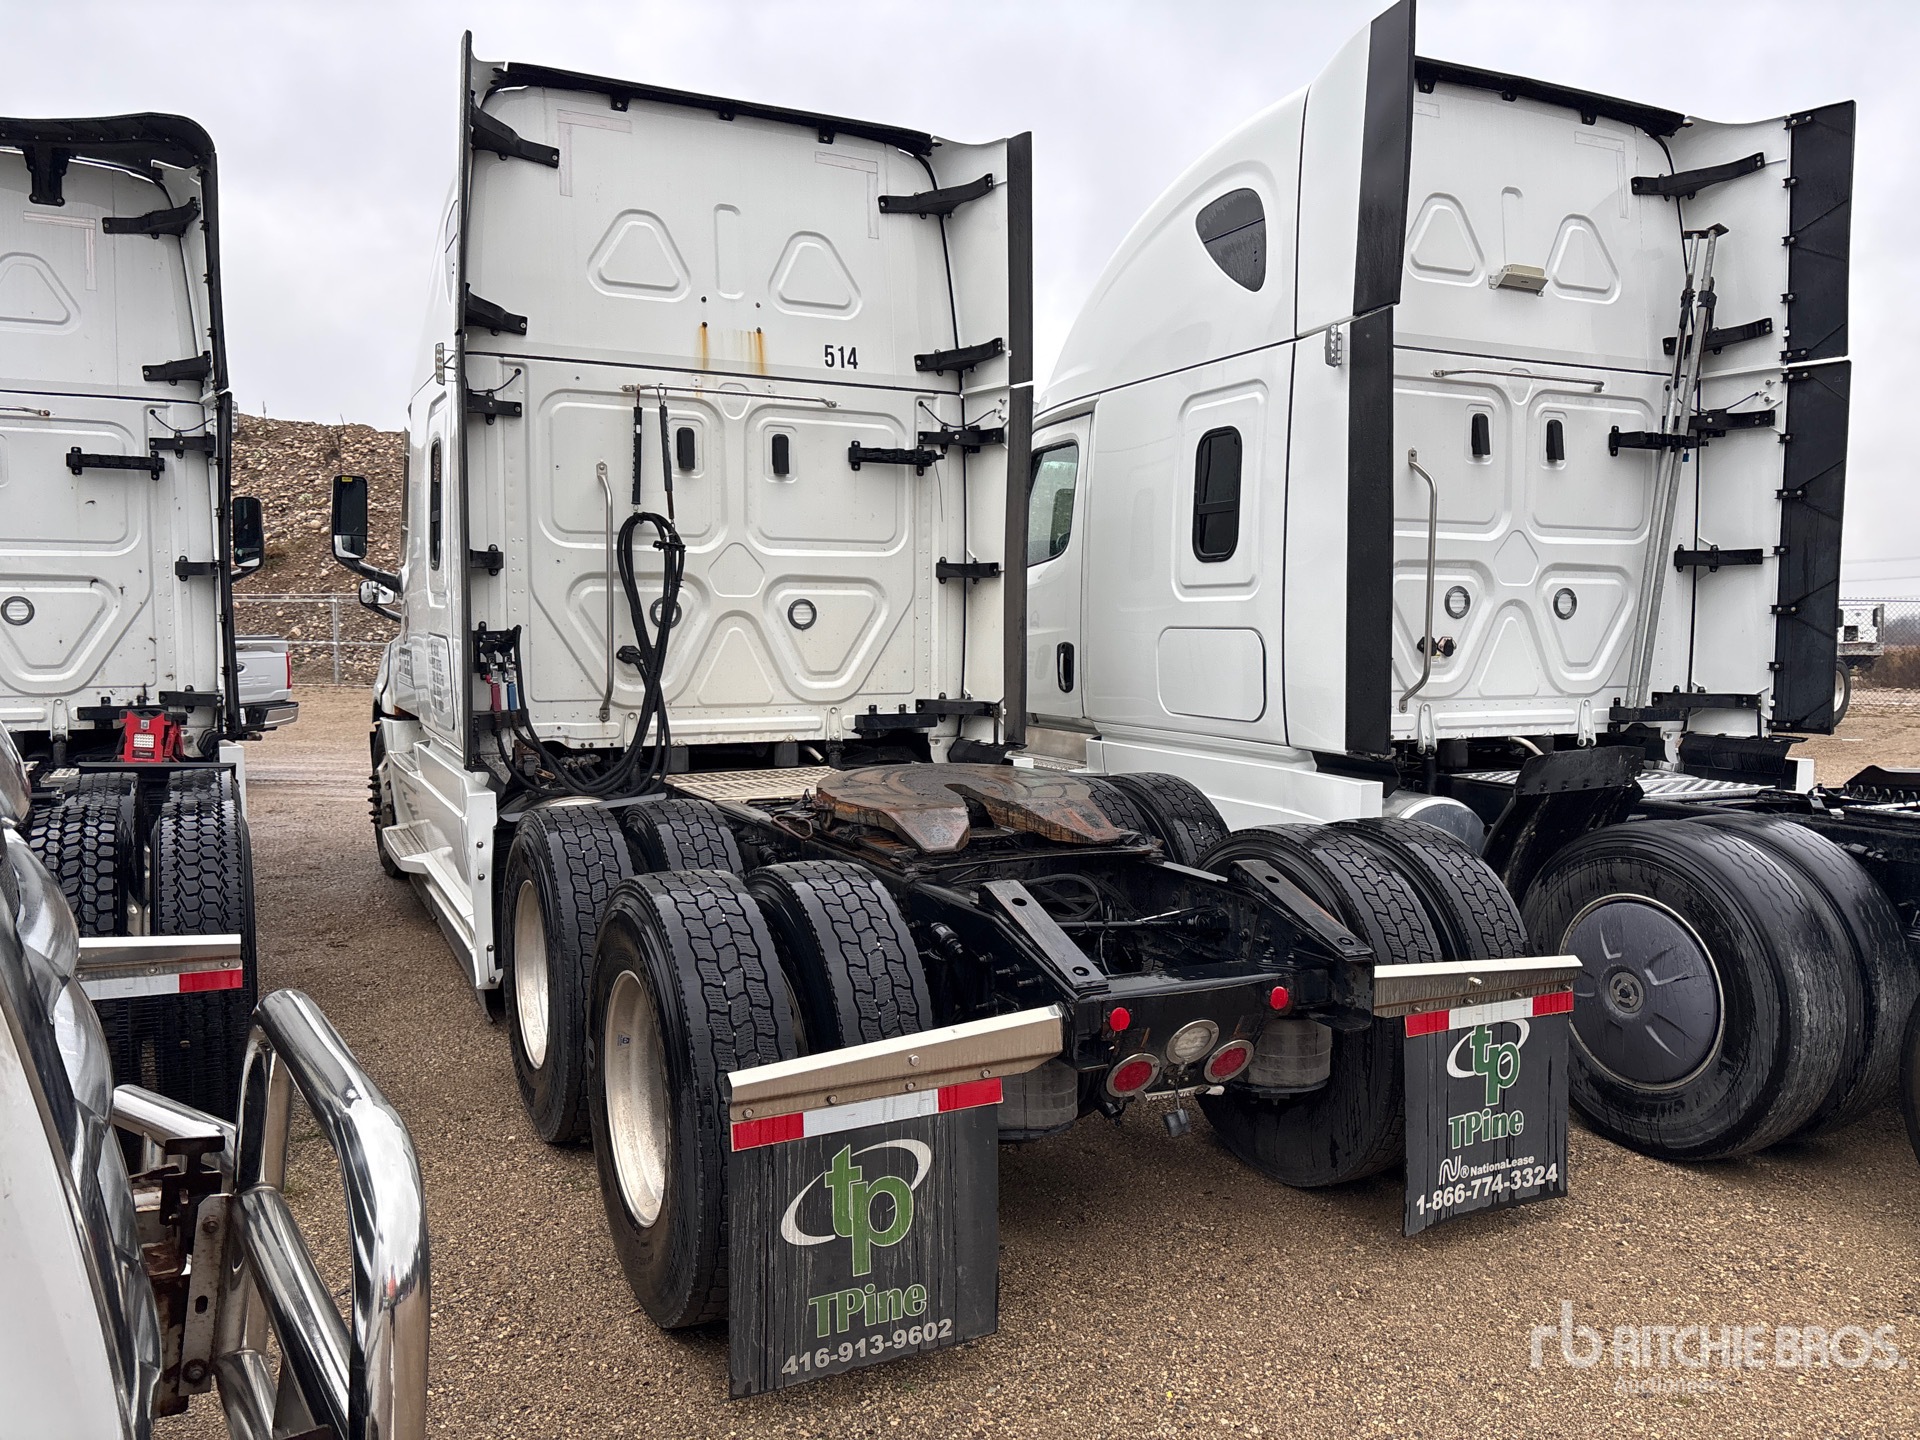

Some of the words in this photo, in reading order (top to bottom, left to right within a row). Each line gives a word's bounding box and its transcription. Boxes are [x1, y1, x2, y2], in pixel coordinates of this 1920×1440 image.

[825, 344, 858, 369] 514
[1449, 1108, 1524, 1150] TPine
[1416, 1163, 1558, 1215] 1-866-774-3324
[1470, 1155, 1535, 1177] NationaLease
[809, 1283, 927, 1338] TPine
[781, 1318, 952, 1375] 416-913-9602
